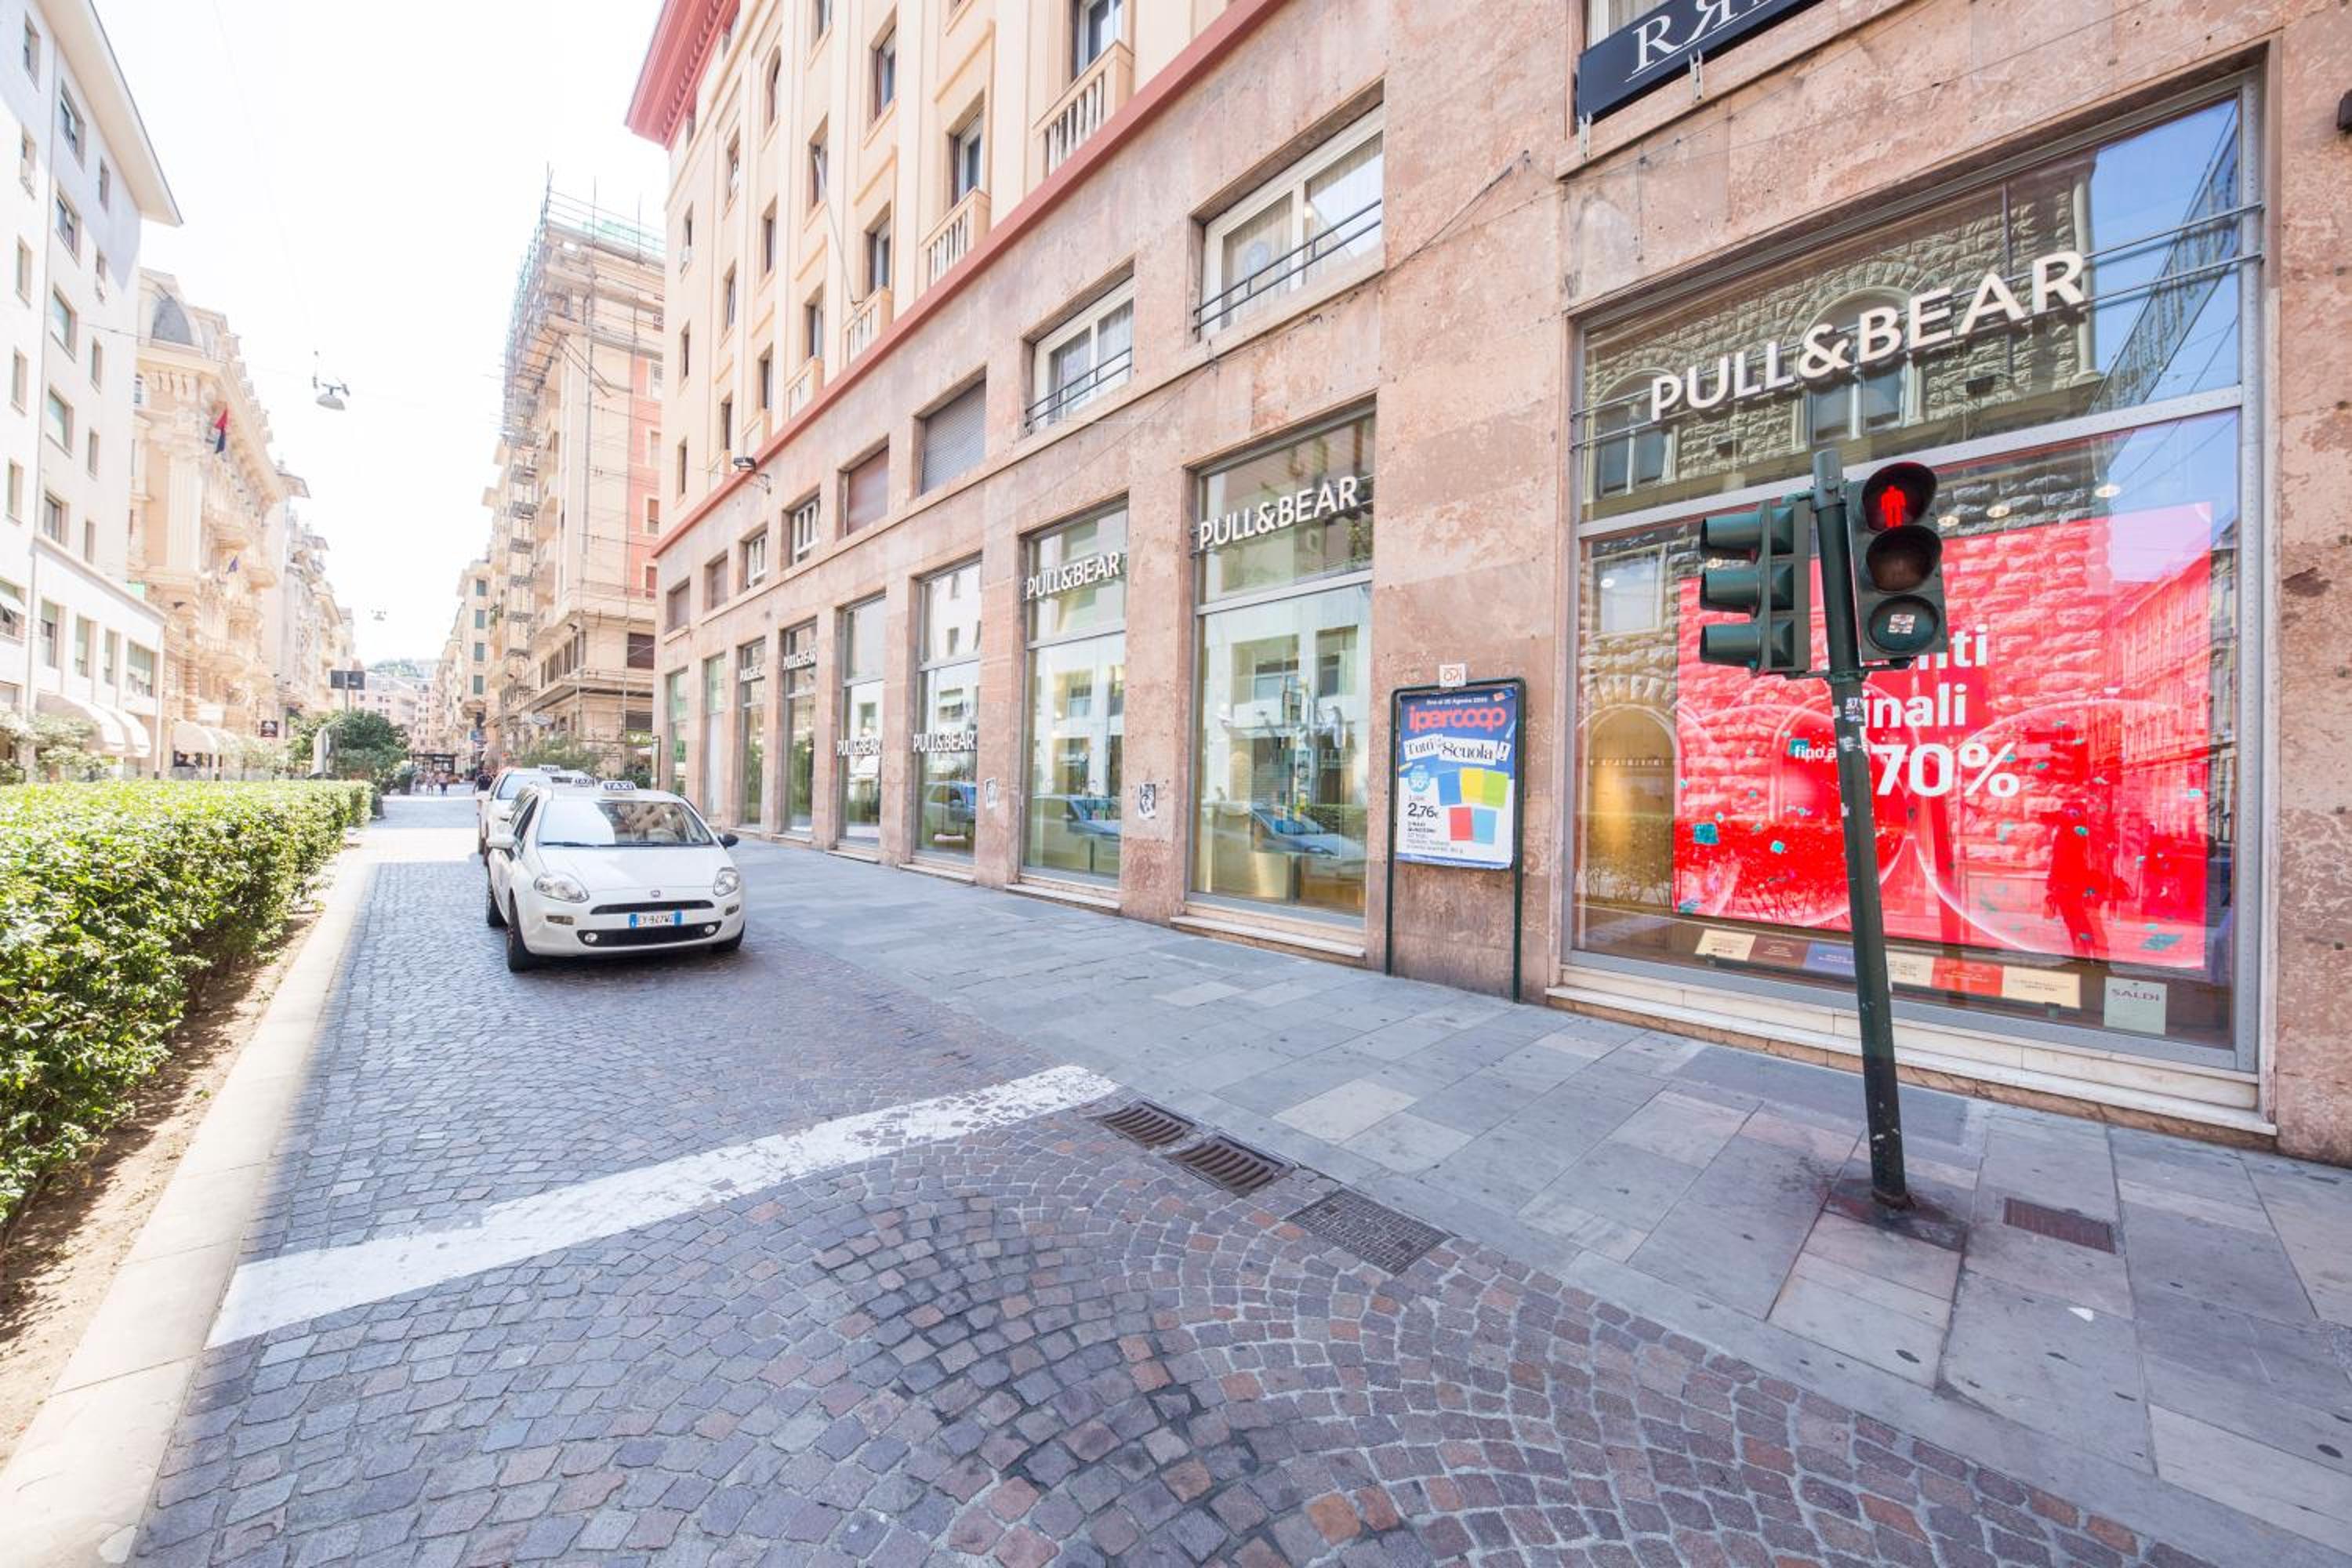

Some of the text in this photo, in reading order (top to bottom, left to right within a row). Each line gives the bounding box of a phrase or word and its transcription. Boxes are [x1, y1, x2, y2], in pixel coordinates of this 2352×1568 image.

[1650, 250, 2086, 423] PULL&BEAR
[1199, 475, 1359, 550] PULL&BEAR
[1025, 551, 1120, 600] PULL&BEAR
[1409, 706, 1506, 732] ipercoop
[913, 730, 976, 753] PULL&BEAR
[604, 782, 633, 791] TAXI
[1871, 742, 2020, 797] 70%
[2111, 987, 2160, 1002] SALDI
